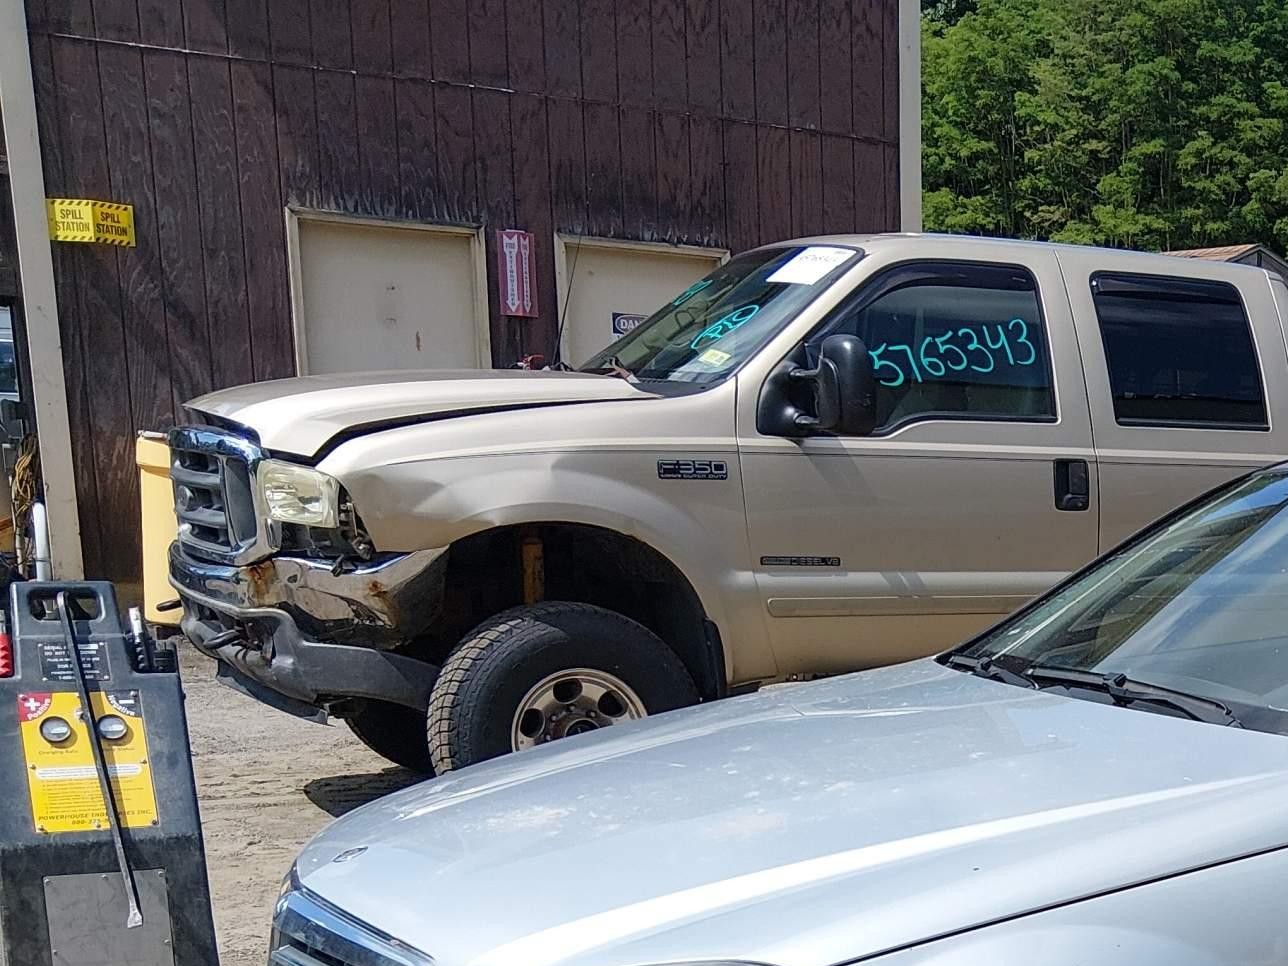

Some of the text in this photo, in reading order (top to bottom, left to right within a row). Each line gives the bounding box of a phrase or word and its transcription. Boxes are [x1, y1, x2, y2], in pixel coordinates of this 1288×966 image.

[60, 209, 84, 219] SPILL
[101, 212, 121, 224] SPILL
[56, 221, 90, 232] STATION
[96, 223, 128, 236] STATION
[868, 319, 1036, 387] 5765343
